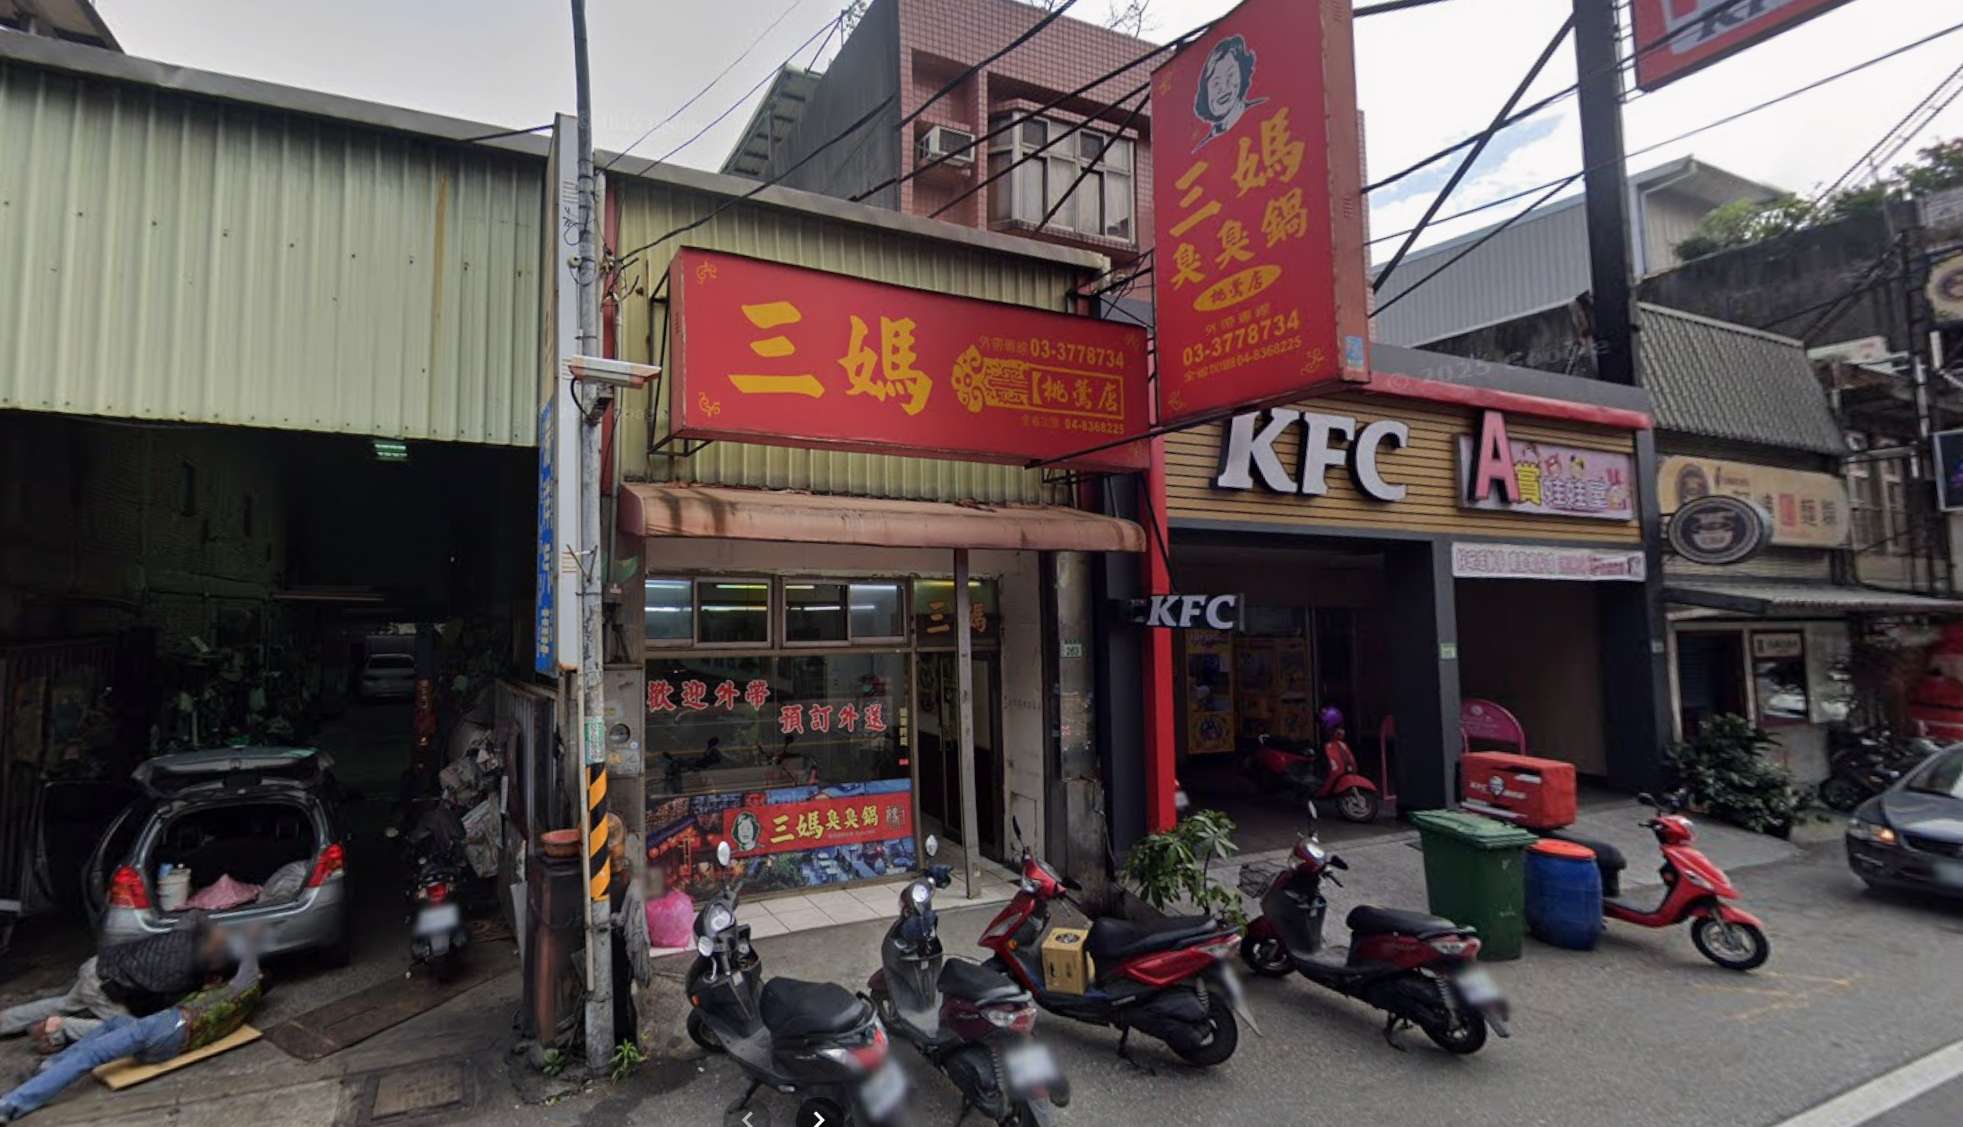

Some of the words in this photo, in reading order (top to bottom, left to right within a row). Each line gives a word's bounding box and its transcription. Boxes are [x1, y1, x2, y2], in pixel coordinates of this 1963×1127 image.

[1169, 107, 1304, 237] 三媽
[1169, 188, 1308, 291] 臭臭鍋
[728, 301, 933, 416] 三媽
[1029, 337, 1125, 370] 03-3778734
[1182, 307, 1302, 367] 03-3778734
[1216, 406, 1409, 502] KFC
[1146, 594, 1237, 631] KFC
[647, 679, 770, 712] 歡迎外帶
[778, 703, 888, 735] 預訂外送
[769, 805, 879, 844] 三媽臭臭鍋
